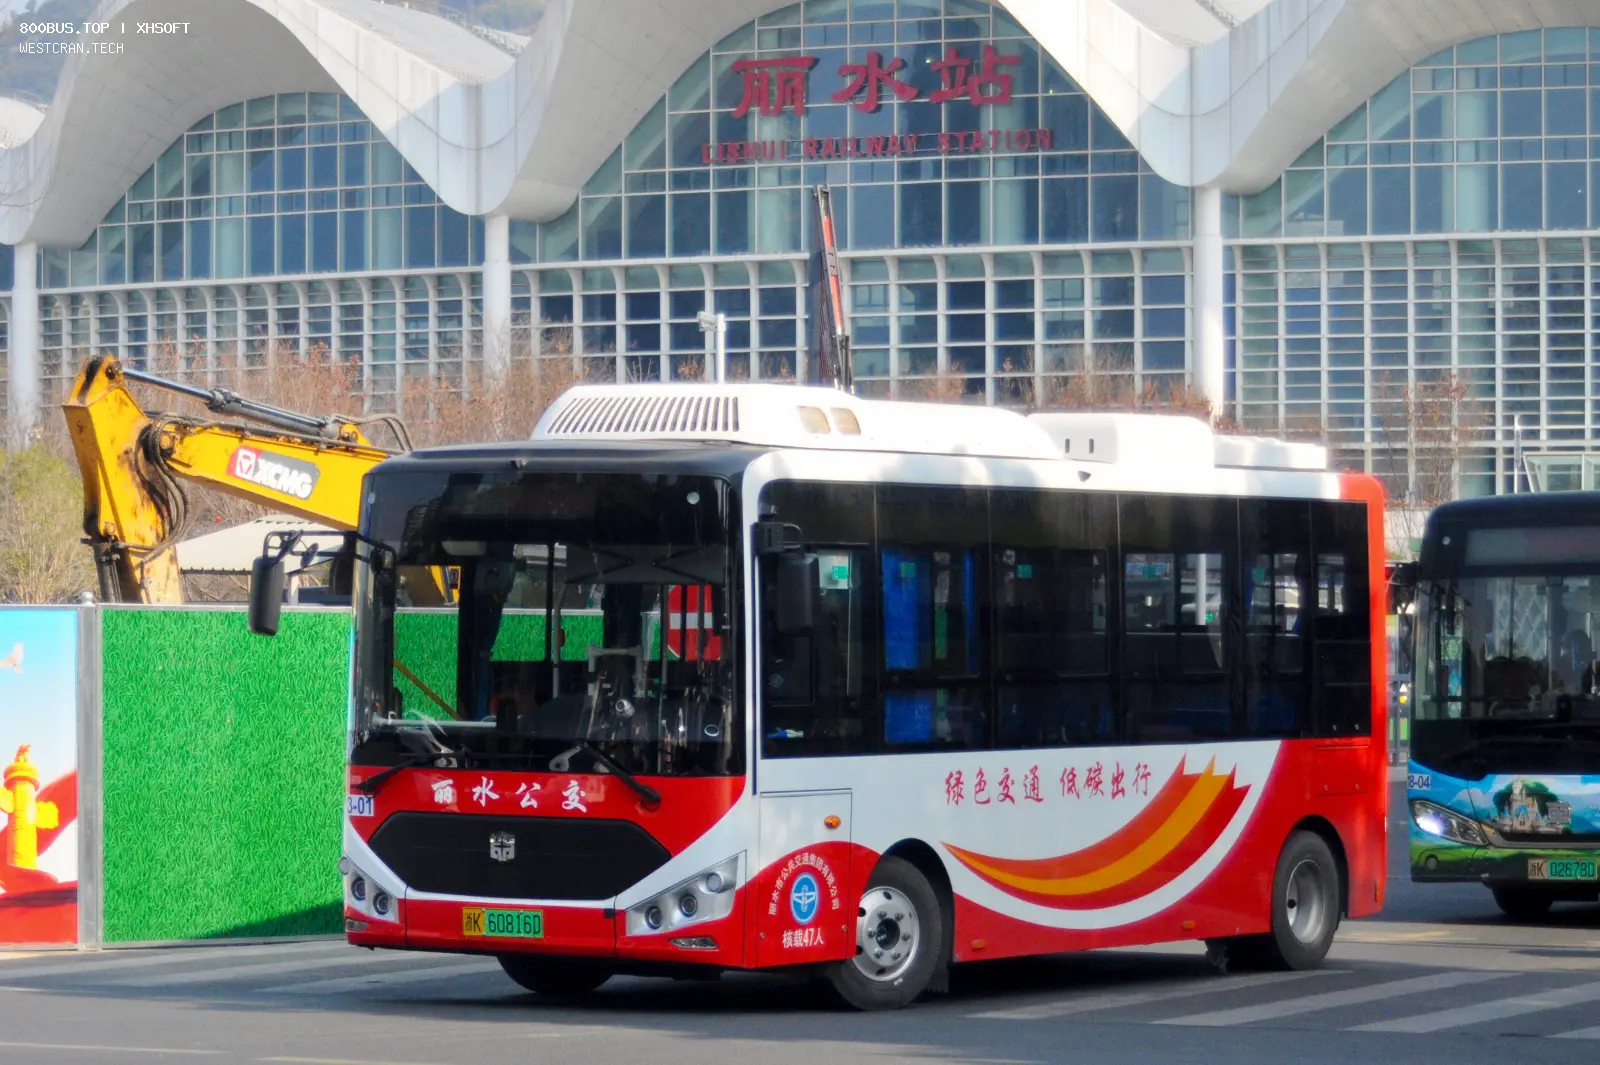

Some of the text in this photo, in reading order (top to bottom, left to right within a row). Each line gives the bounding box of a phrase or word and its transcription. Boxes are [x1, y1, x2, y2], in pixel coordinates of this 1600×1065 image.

[731, 45, 1022, 119] 丽水站
[702, 128, 1054, 164] LISHUI RAILWAY STATION
[252, 458, 312, 499] XCMG
[431, 775, 588, 813] 丽水公交
[944, 761, 1152, 806] 绿色交通 低碳出行
[782, 927, 824, 949] 核载47人
